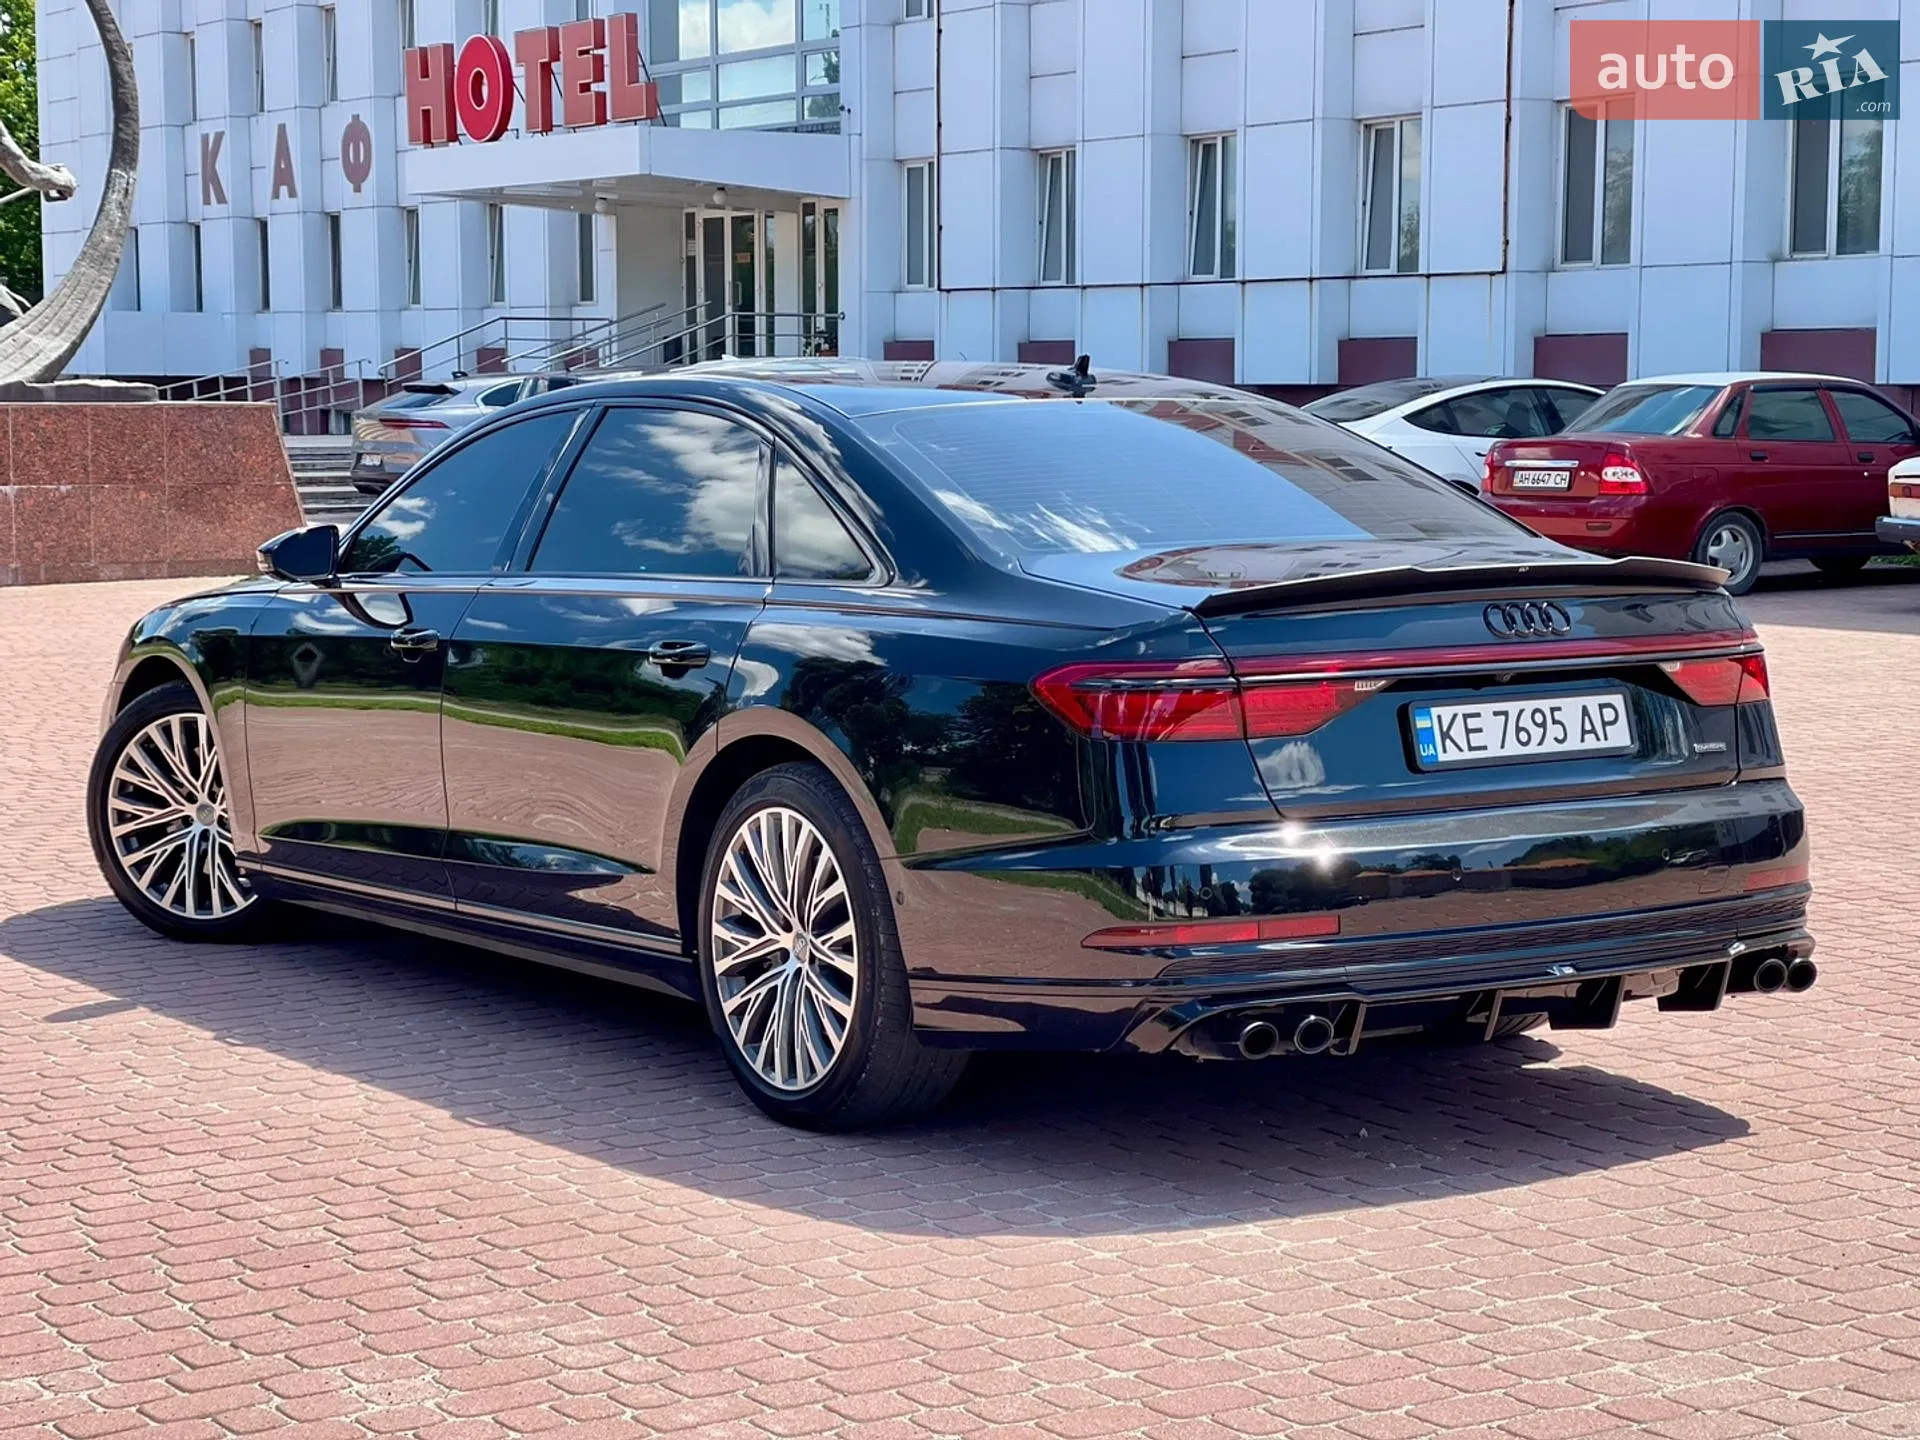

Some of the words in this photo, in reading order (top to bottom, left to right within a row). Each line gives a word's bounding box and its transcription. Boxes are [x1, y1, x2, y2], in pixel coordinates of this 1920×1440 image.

[405, 12, 658, 146] HOTEL
[1420, 743, 1436, 757] UA
[1436, 712, 1488, 755] KE
[1492, 706, 1568, 749] 7695
[1579, 702, 1620, 743] AP
